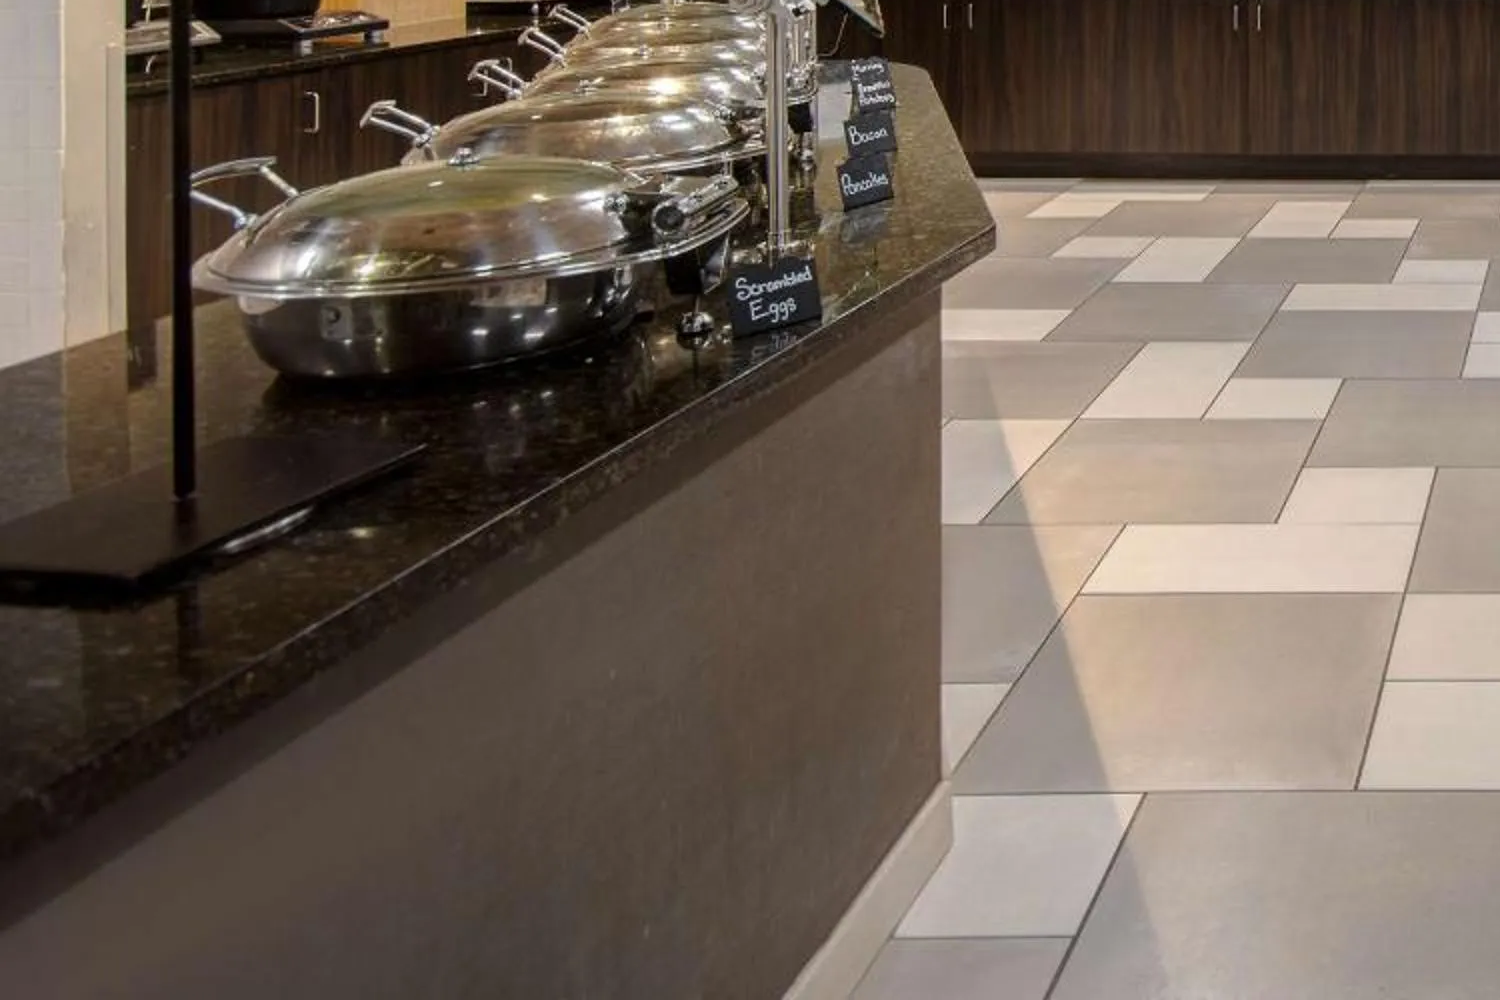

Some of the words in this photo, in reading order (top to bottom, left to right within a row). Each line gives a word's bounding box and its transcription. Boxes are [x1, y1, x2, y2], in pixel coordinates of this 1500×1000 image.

[848, 125, 889, 145] Bacon
[735, 265, 813, 301] Scrambled
[749, 297, 797, 323] Eggs
